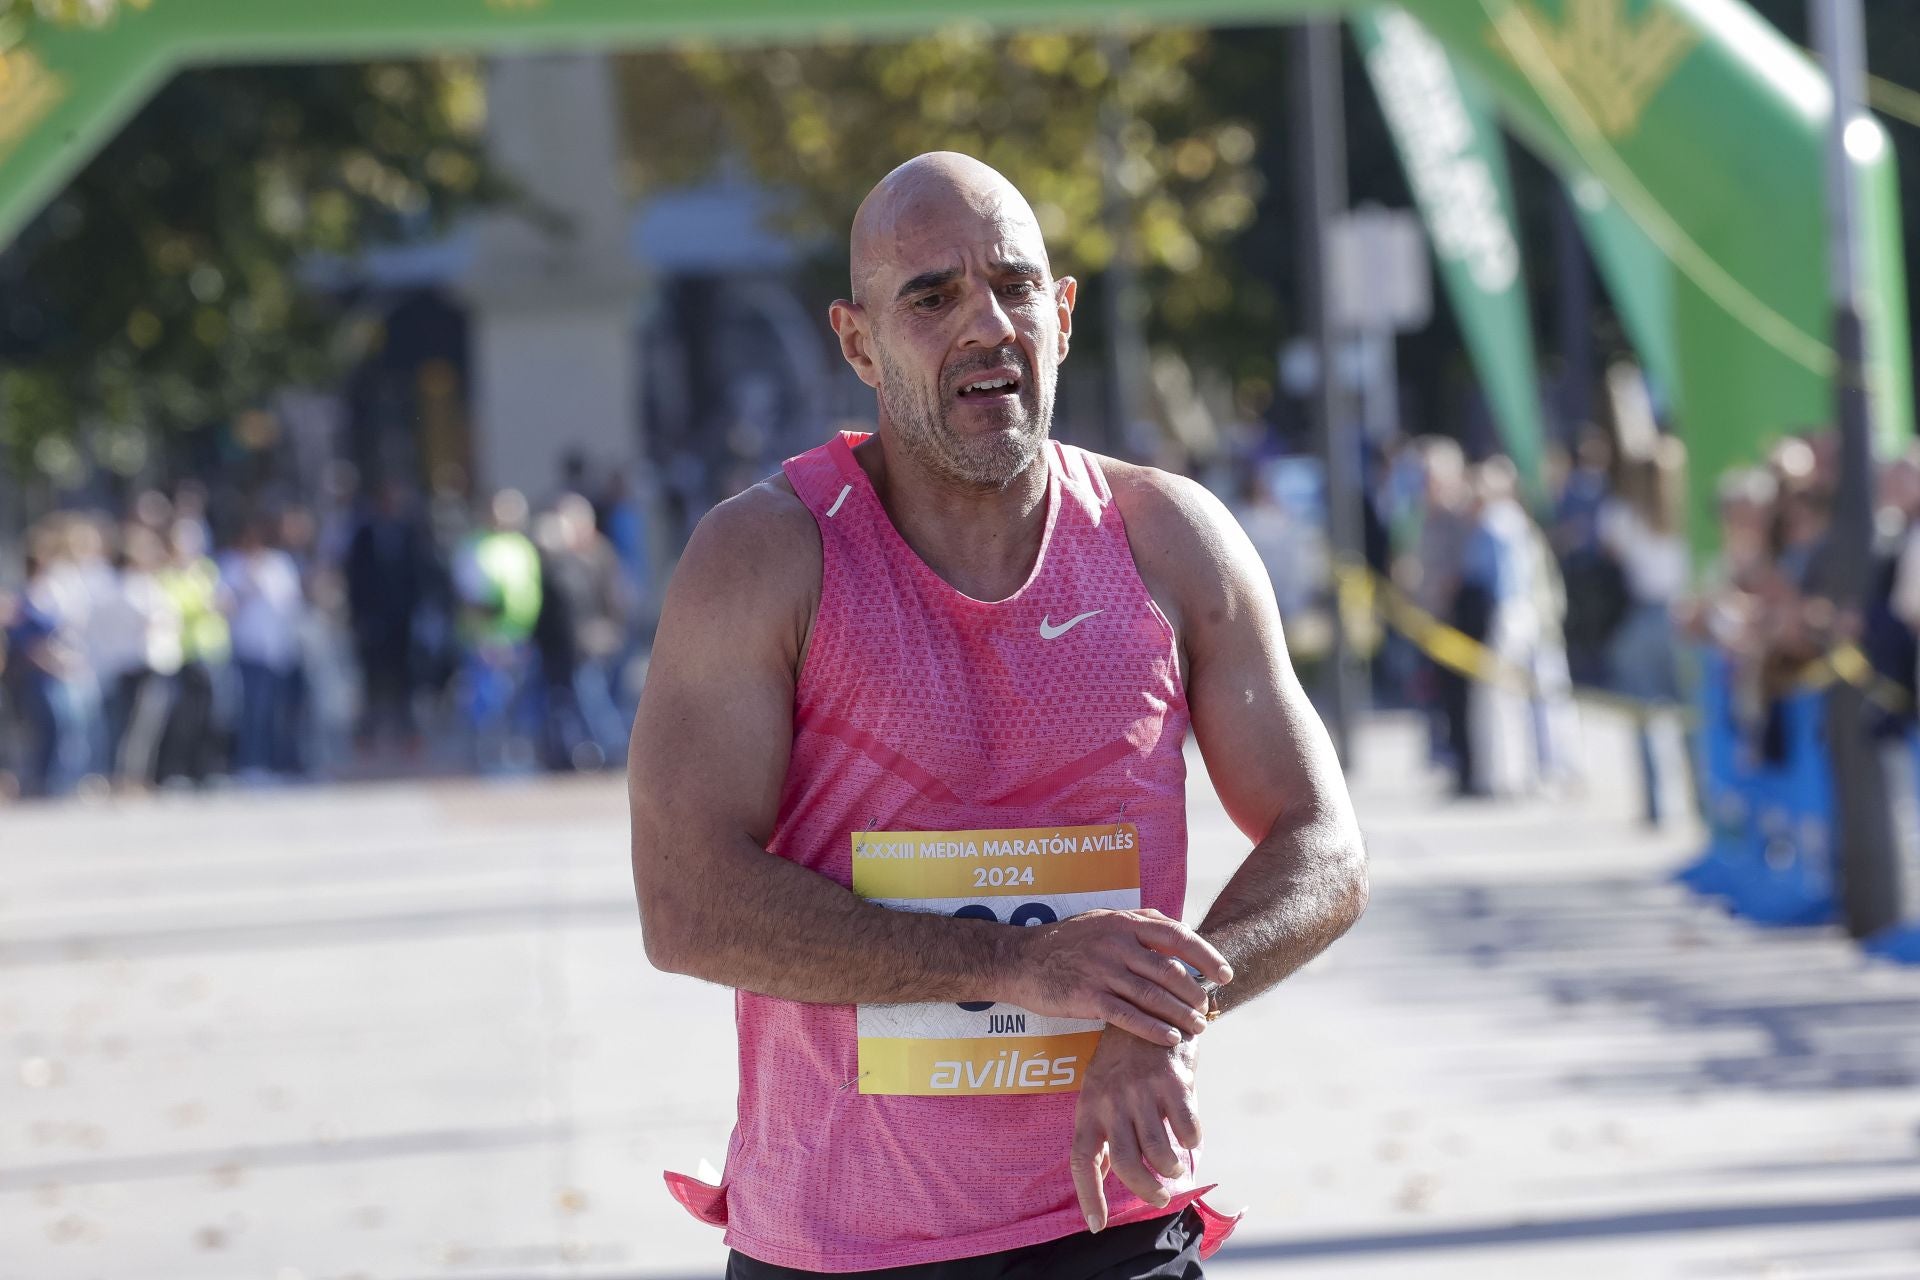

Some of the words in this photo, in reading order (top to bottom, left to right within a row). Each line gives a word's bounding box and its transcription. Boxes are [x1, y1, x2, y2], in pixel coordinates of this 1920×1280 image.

[919, 842, 979, 859] MEDIA
[983, 835, 1077, 857] MARATÓN
[1081, 830, 1134, 853] AVILÉS
[973, 866, 1035, 888] 2024
[987, 1013, 1026, 1034] JUAN
[929, 1050, 1077, 1090] avilés
